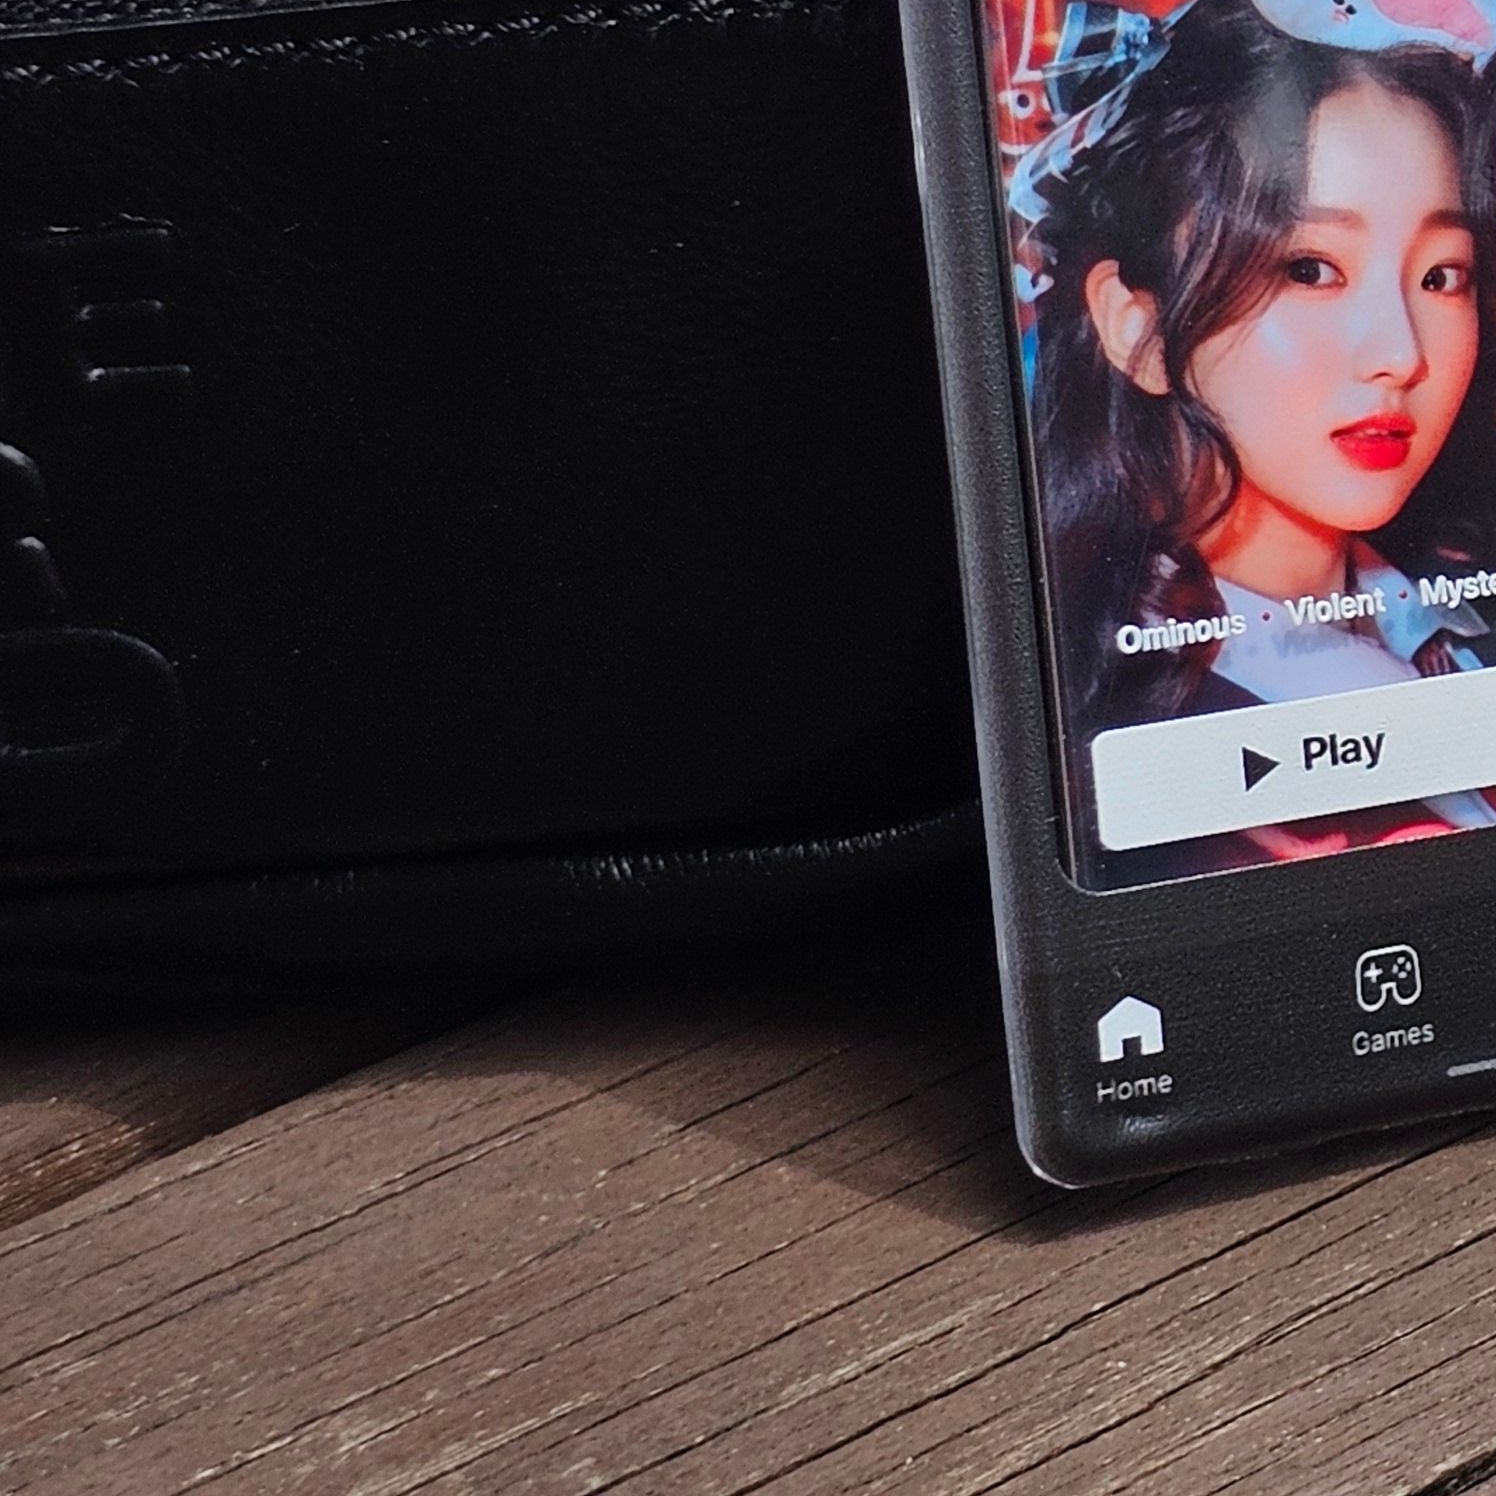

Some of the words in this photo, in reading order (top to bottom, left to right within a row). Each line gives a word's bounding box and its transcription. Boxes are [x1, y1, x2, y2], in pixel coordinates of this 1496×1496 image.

[1116, 611, 1247, 655] Ominous
[1284, 587, 1387, 627] Violent
[1302, 732, 1386, 771] Play
[1352, 1022, 1435, 1057] Games
[1096, 1071, 1174, 1104] Home
